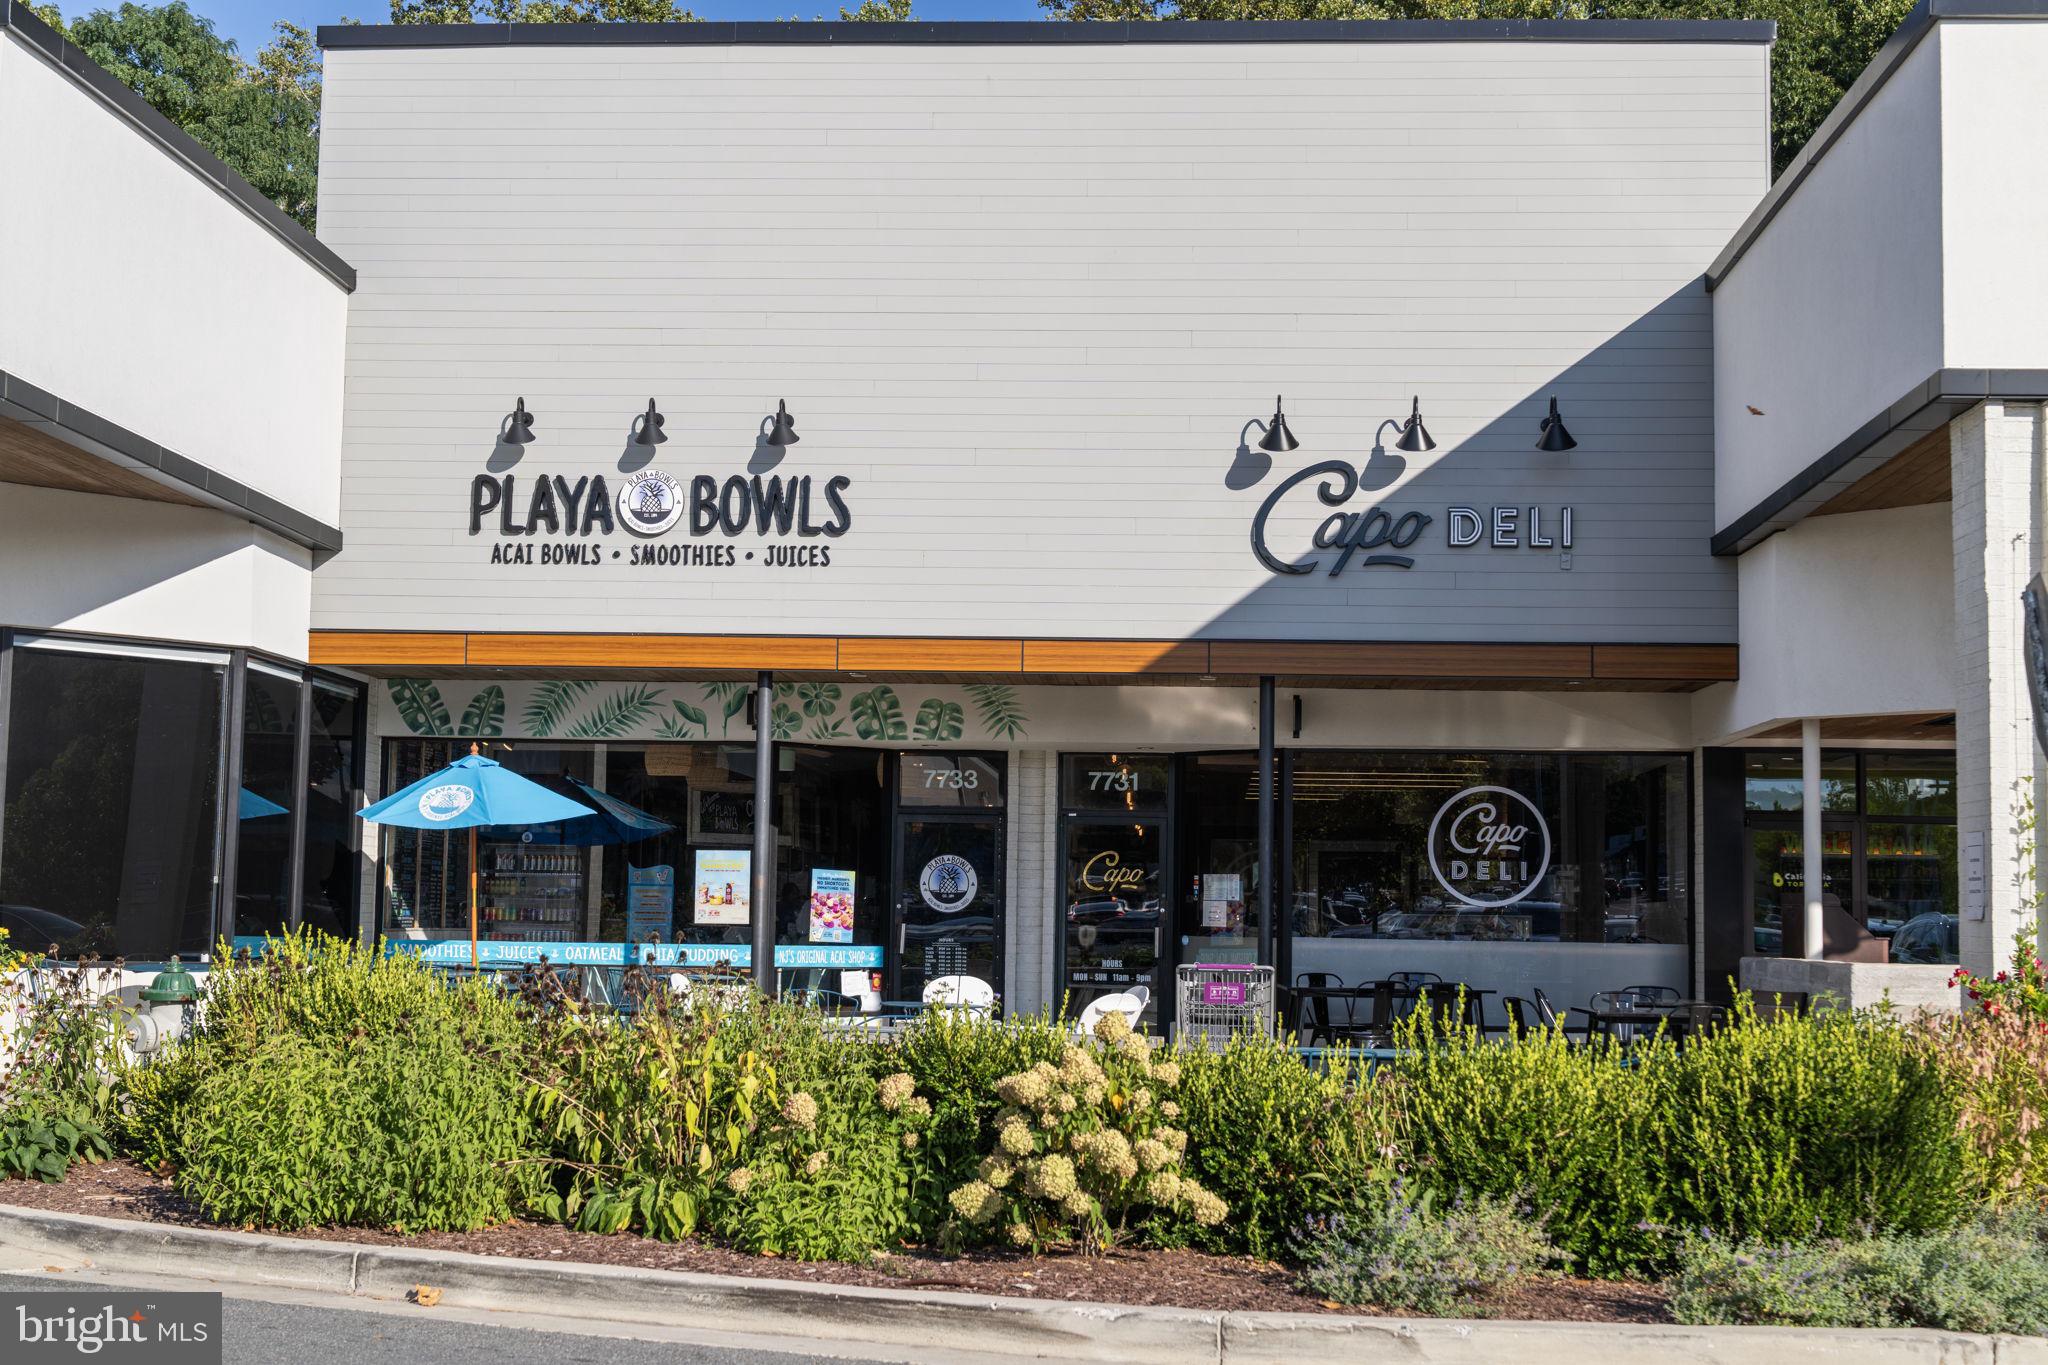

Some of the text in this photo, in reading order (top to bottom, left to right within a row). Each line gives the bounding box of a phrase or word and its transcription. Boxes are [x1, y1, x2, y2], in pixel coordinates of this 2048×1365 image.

[628, 470, 679, 490] PLAYA BOWLS
[473, 474, 851, 535] PLAYA BOWLS
[1251, 460, 1573, 577] Capo DELI
[491, 543, 831, 567] ACAI BOWLS SMOOTHIES JUICES
[923, 769, 978, 789] 7733
[1088, 771, 1139, 791] 7731
[1449, 802, 1529, 856] Capo
[927, 855, 973, 873] PLAYA BOWLS
[1082, 850, 1144, 892] Capo
[1451, 860, 1528, 881] DELI
[1785, 873, 1832, 881] Caliia
[495, 945, 543, 960] JUICES
[565, 946, 624, 961] OATMEAL
[643, 947, 675, 961] CHIA
[779, 949, 866, 964] NJ'S ORIGINAL ACAI SHOP
[1101, 959, 1123, 968] HOURS
[1073, 972, 1088, 981] MON
[1094, 973, 1108, 981] SUN
[1112, 973, 1130, 982] 11am
[1135, 973, 1152, 982] 9pm
